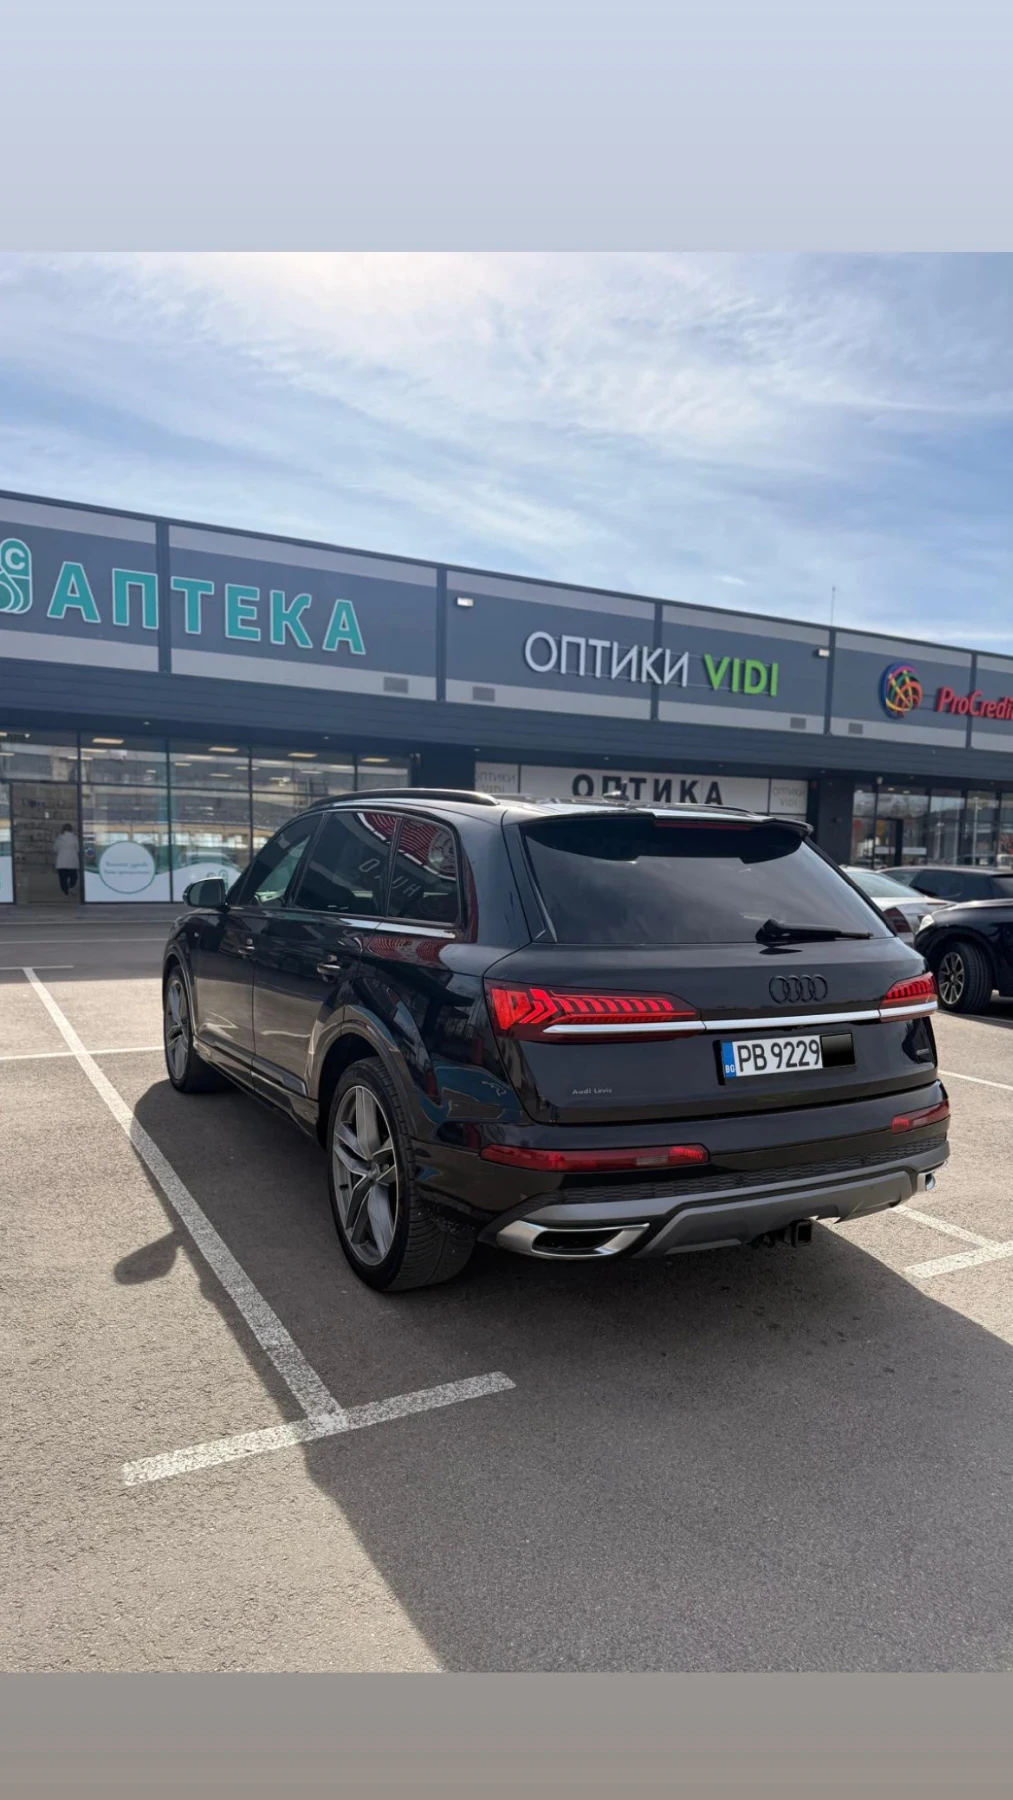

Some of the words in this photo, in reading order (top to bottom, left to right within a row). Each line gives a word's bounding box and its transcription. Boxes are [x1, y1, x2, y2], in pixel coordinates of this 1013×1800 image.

[47, 561, 366, 655] АПТЕКА
[524, 631, 689, 688] ОПТИКИ
[704, 653, 779, 697] VIDI
[935, 685, 1013, 721] ProCredi
[572, 773, 721, 805] ОПТИКА
[725, 1064, 736, 1073] BG
[770, 1039, 820, 1069] 9229
[572, 1087, 592, 1095] Audi
